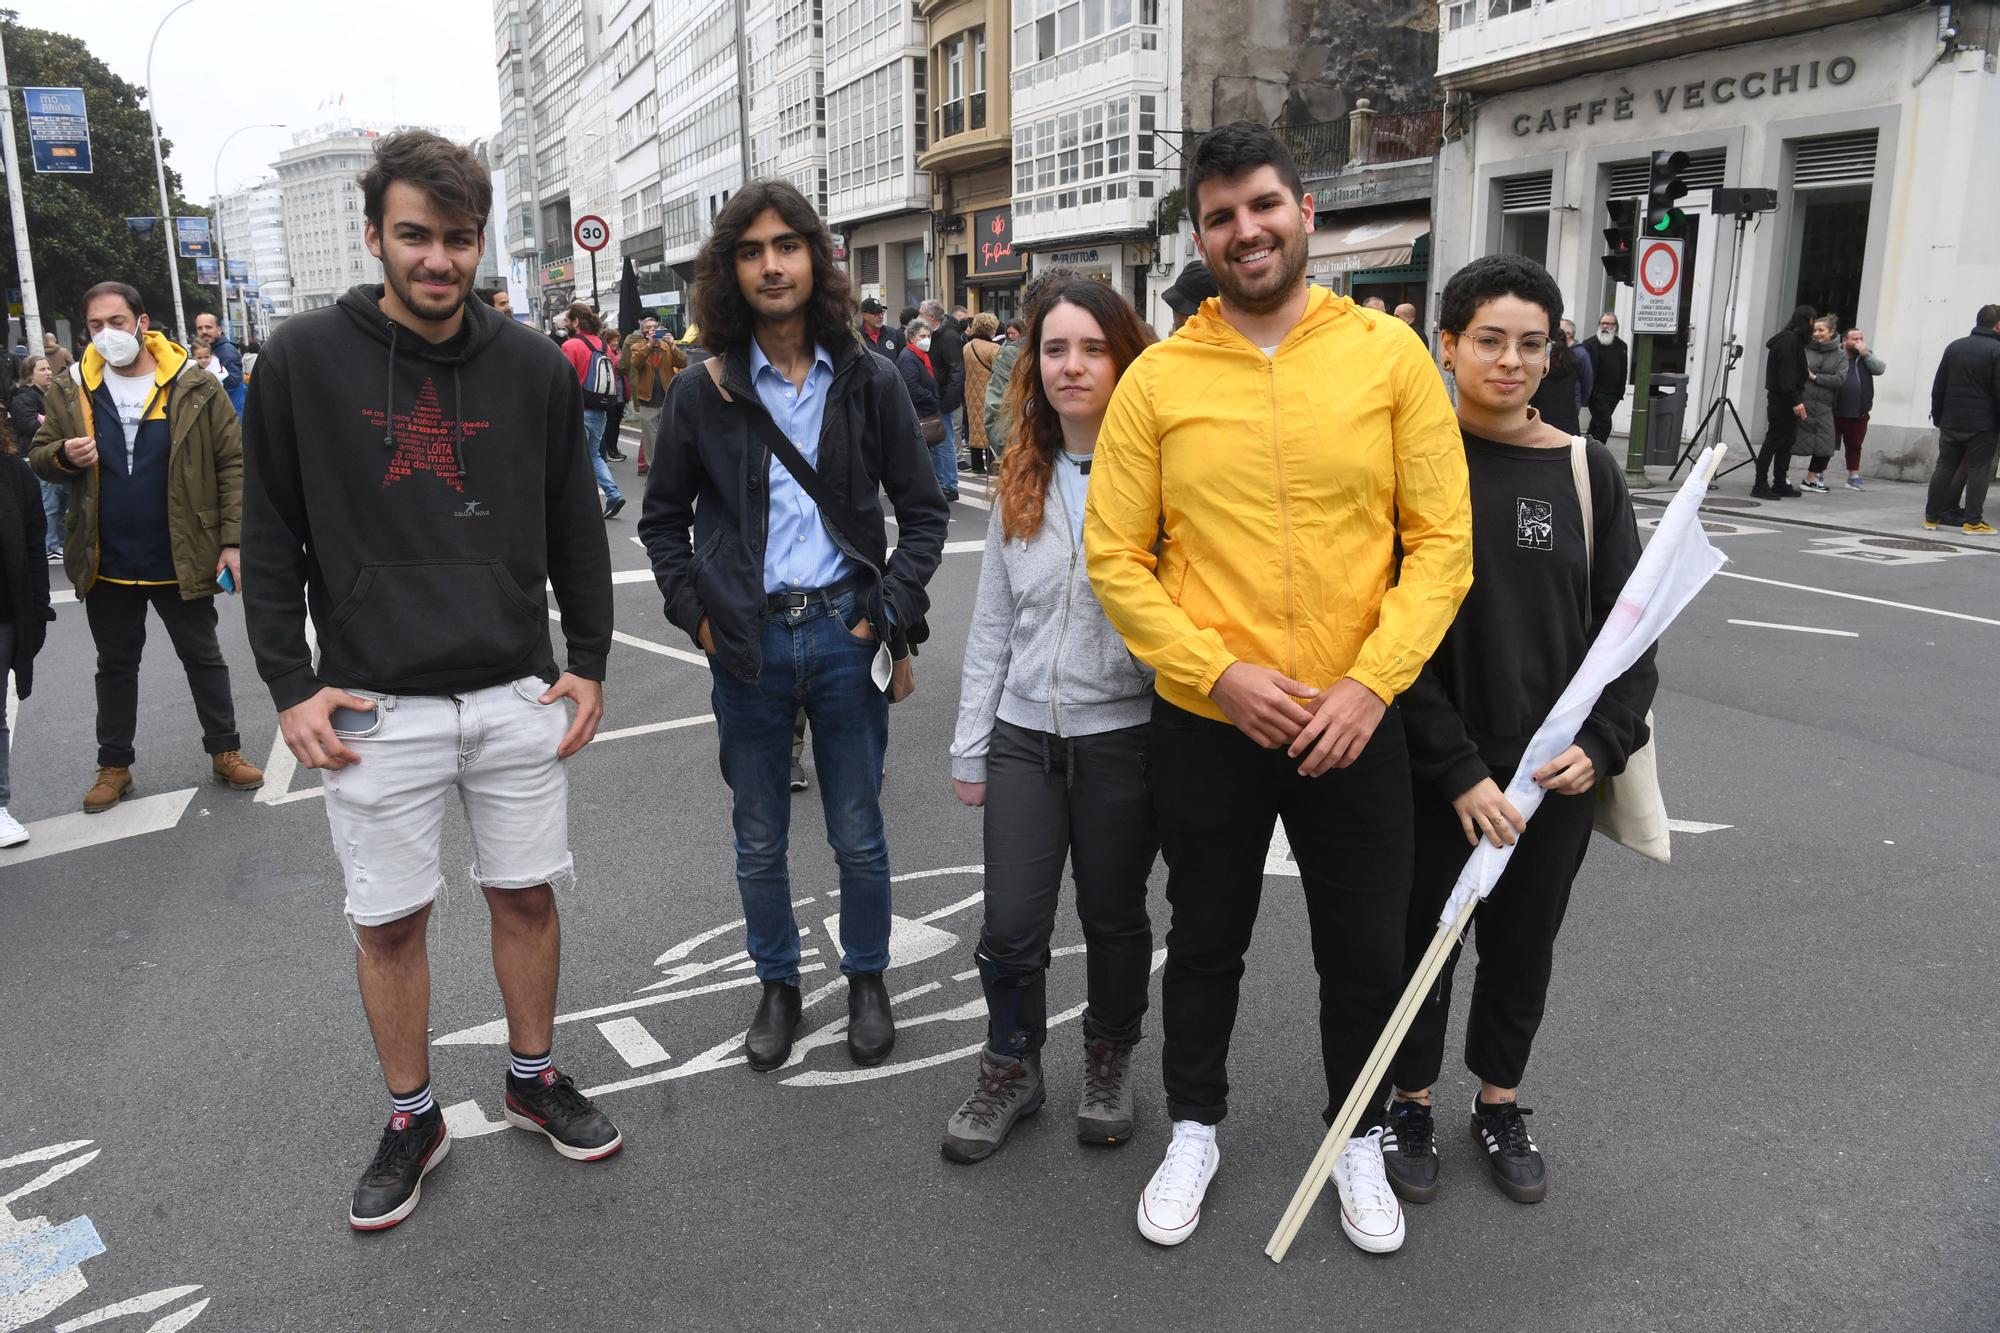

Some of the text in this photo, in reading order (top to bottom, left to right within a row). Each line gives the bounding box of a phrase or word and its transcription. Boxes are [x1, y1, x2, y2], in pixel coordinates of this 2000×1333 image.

[1511, 55, 1856, 137] CAFFÈ VECCHIO
[583, 227, 601, 239] 30
[361, 408, 372, 416] se
[413, 418, 438, 426] soños
[427, 443, 452, 455] LOITA
[395, 451, 402, 459] a
[427, 454, 455, 463] mao
[391, 458, 411, 467] che
[413, 460, 431, 469] dou
